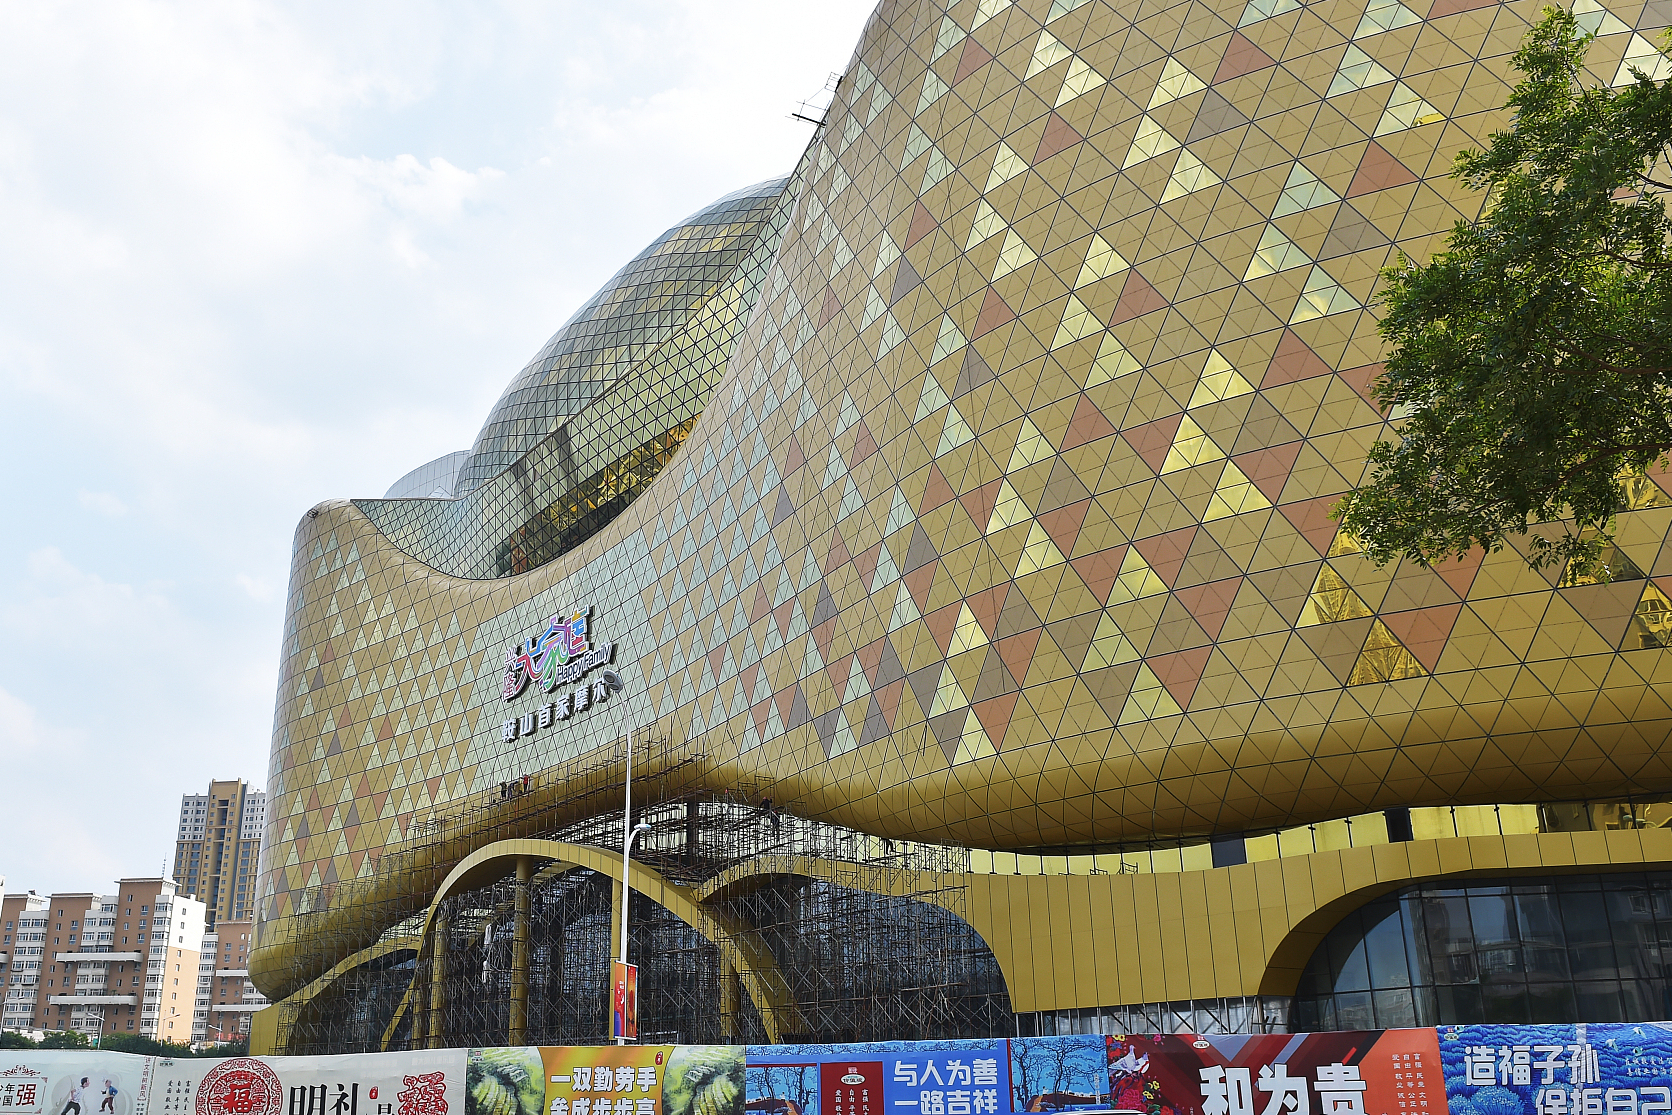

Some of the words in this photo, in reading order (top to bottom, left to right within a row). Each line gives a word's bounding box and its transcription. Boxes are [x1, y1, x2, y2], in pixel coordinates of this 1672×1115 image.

[893, 1058, 998, 1087] 与人为善
[1464, 1044, 1600, 1085] 造福子孙
[551, 1066, 657, 1092] 一双勤劳手
[1198, 1062, 1367, 1115] 和为贵
[0, 1096, 13, 1106] 国
[15, 1083, 36, 1106] 强
[894, 1089, 998, 1115] 一路吉祥
[1536, 1086, 1671, 1115] 保护自己
